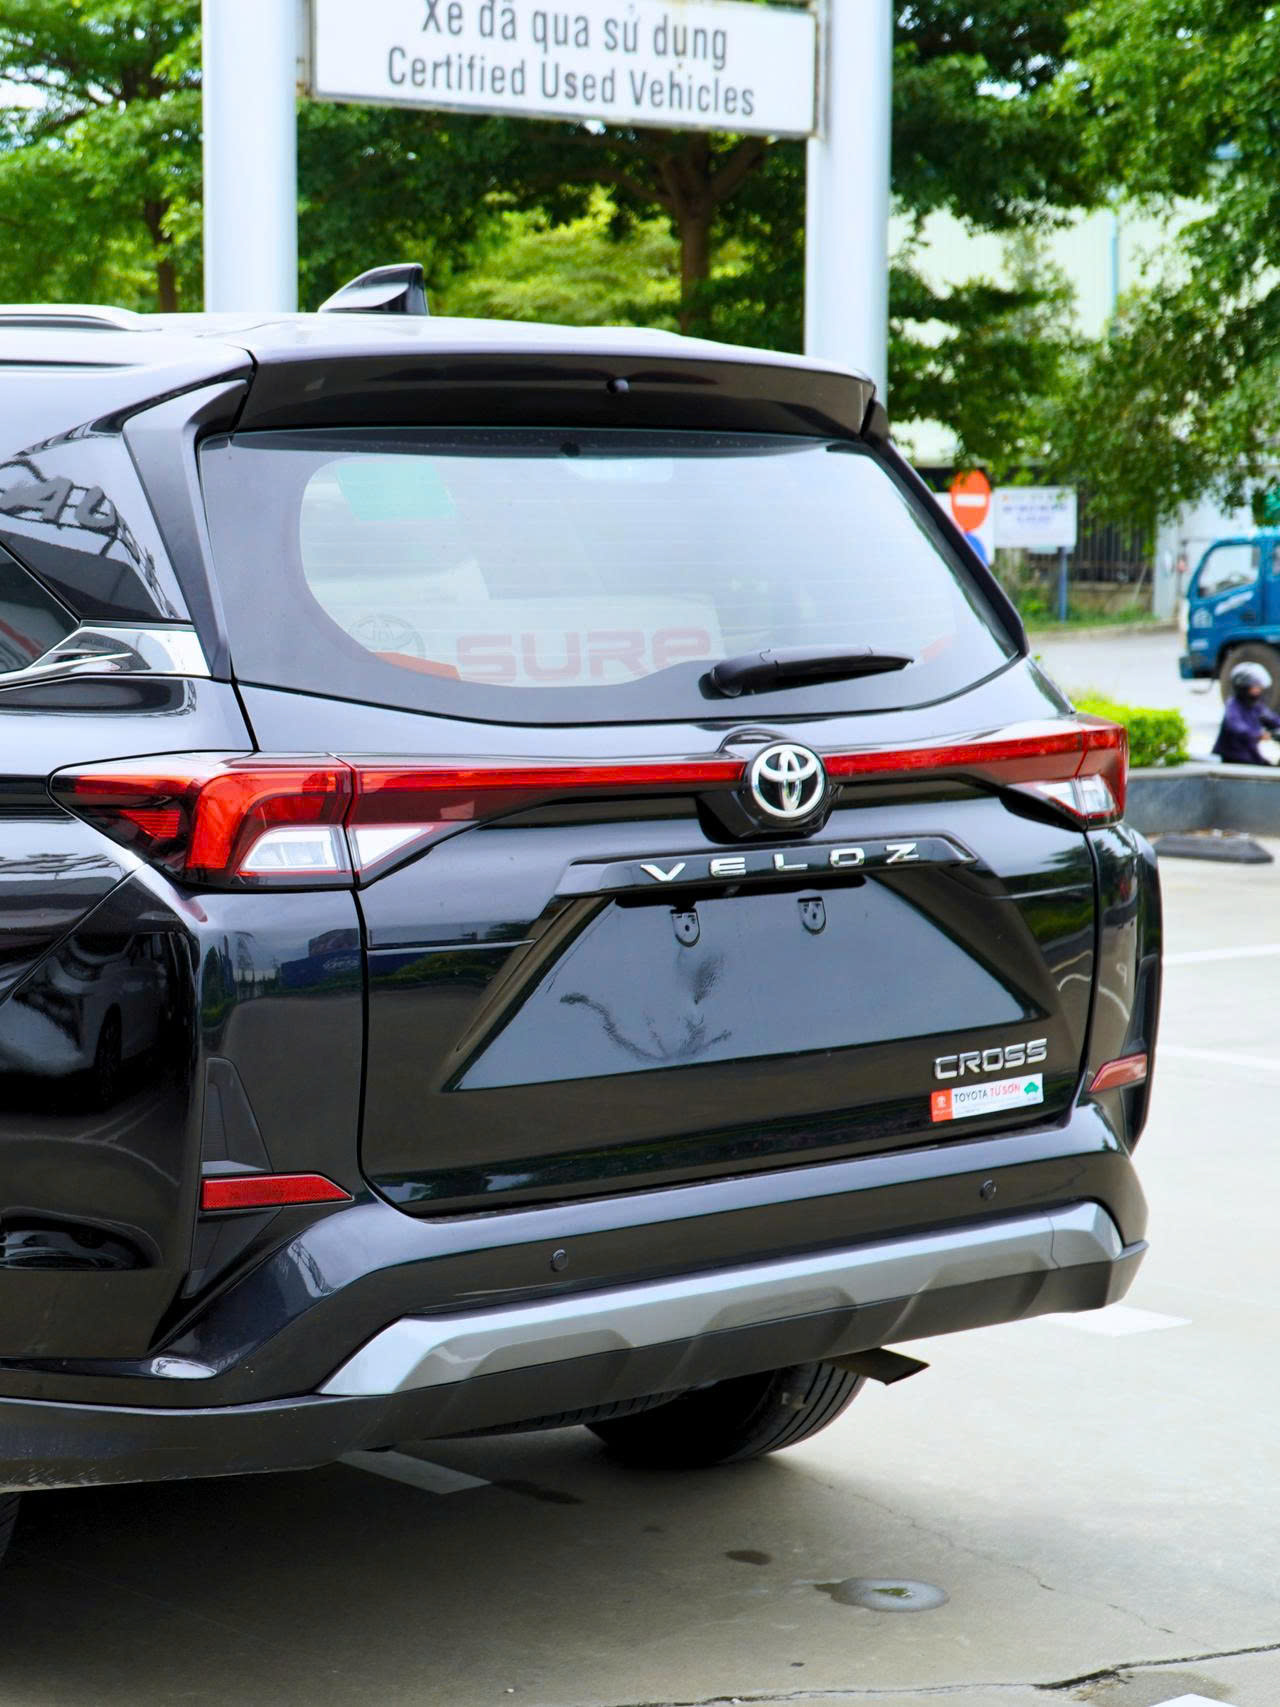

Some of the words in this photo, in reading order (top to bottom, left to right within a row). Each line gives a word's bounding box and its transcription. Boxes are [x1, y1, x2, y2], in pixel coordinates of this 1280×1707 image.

[422, 0, 463, 35] Xe
[533, 10, 589, 54] qua
[653, 14, 727, 71] dụng
[388, 46, 526, 96] Certified
[541, 61, 615, 104] Used
[630, 69, 754, 116] Vehicles
[640, 842, 920, 882] VELOZ
[934, 1037, 1048, 1079] CROSS
[954, 1088, 988, 1104] TOYOTA
